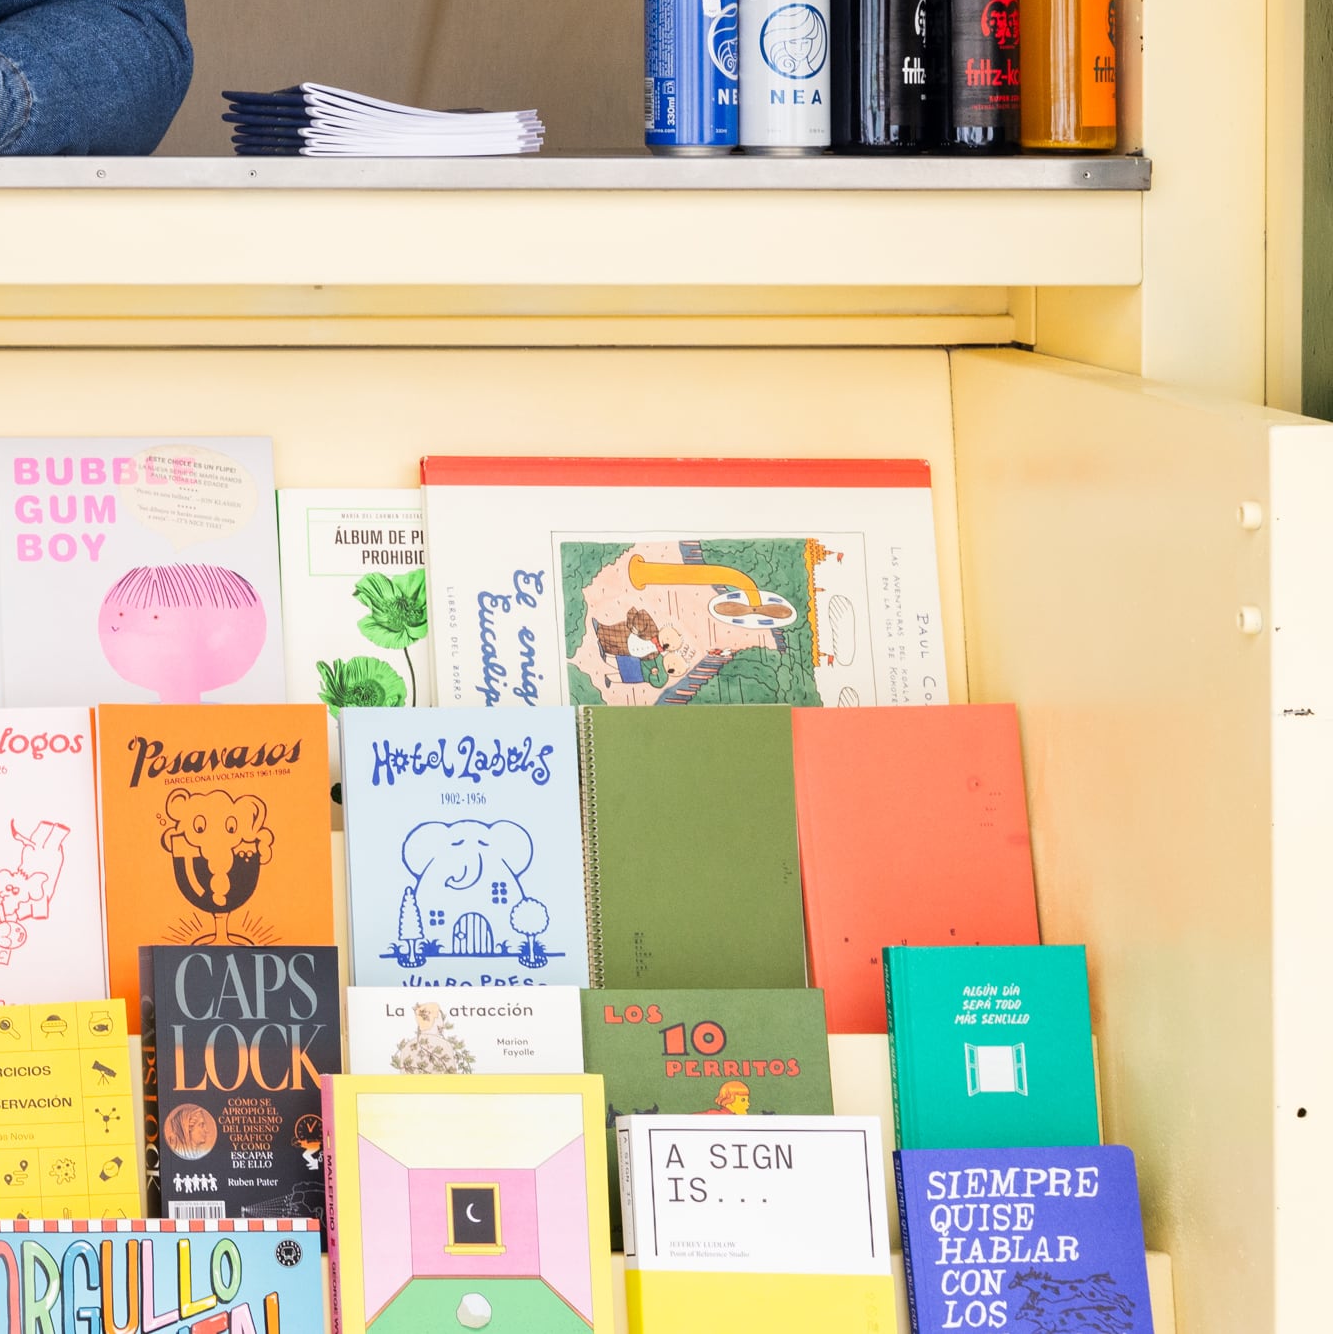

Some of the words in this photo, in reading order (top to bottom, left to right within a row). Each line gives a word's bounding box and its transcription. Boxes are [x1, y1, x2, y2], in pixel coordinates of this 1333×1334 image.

[15, 495, 116, 524] GUM
[17, 533, 105, 562] BOY
[128, 736, 301, 787] Posavasos
[442, 793, 486, 804] 1902-1956
[175, 953, 317, 1020] CAPS
[963, 983, 997, 996] ALGÚN
[1002, 983, 1020, 996] DÍA
[386, 1004, 404, 1016] La
[450, 1003, 532, 1016] atracción
[604, 1004, 663, 1024] LOS
[963, 997, 991, 1010] SERÁ
[996, 999, 1021, 1010] TODO
[955, 1011, 976, 1024] MÁS
[982, 1014, 1030, 1024] SENCILLO
[659, 1020, 727, 1056] 10
[173, 1024, 327, 1093] LOCK
[665, 1058, 800, 1078] PERRITOS
[231, 1152, 273, 1160] ESCAPAR
[233, 1160, 245, 1168] DE
[248, 1160, 272, 1168] ELLO
[666, 1144, 684, 1168] A
[709, 1144, 793, 1170] SIGN
[228, 1178, 254, 1186] Ruben
[257, 1178, 278, 1186] Pater
[927, 1167, 1098, 1200] SIEMPRE
[930, 1204, 1034, 1237] QUISE
[935, 1235, 1079, 1264] HABLAR
[941, 1269, 1006, 1296] CON
[942, 1300, 1007, 1328] LOS
